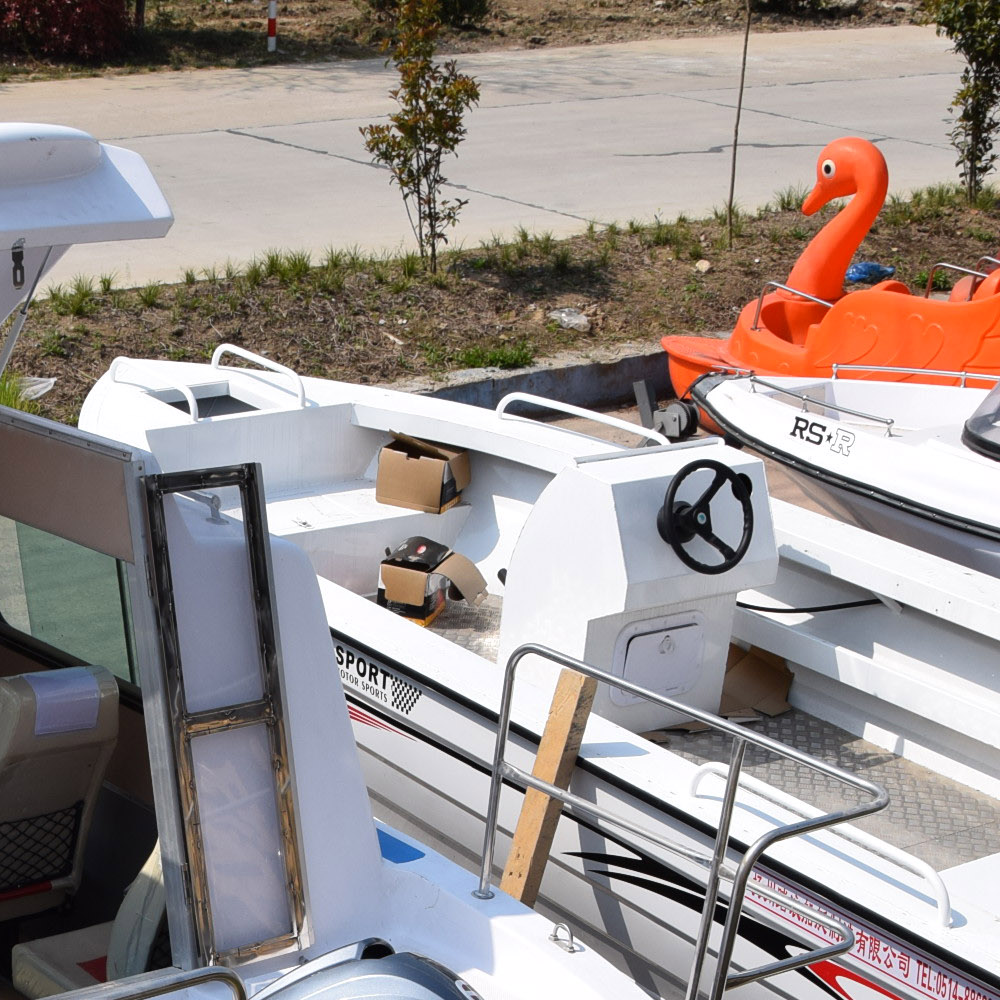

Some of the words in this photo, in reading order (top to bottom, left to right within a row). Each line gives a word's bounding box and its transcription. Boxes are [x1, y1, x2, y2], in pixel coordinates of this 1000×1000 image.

[790, 416, 827, 446] RS
[335, 645, 391, 690] SPORT
[338, 668, 359, 687] OTOR
[361, 681, 388, 703] SPORTS
